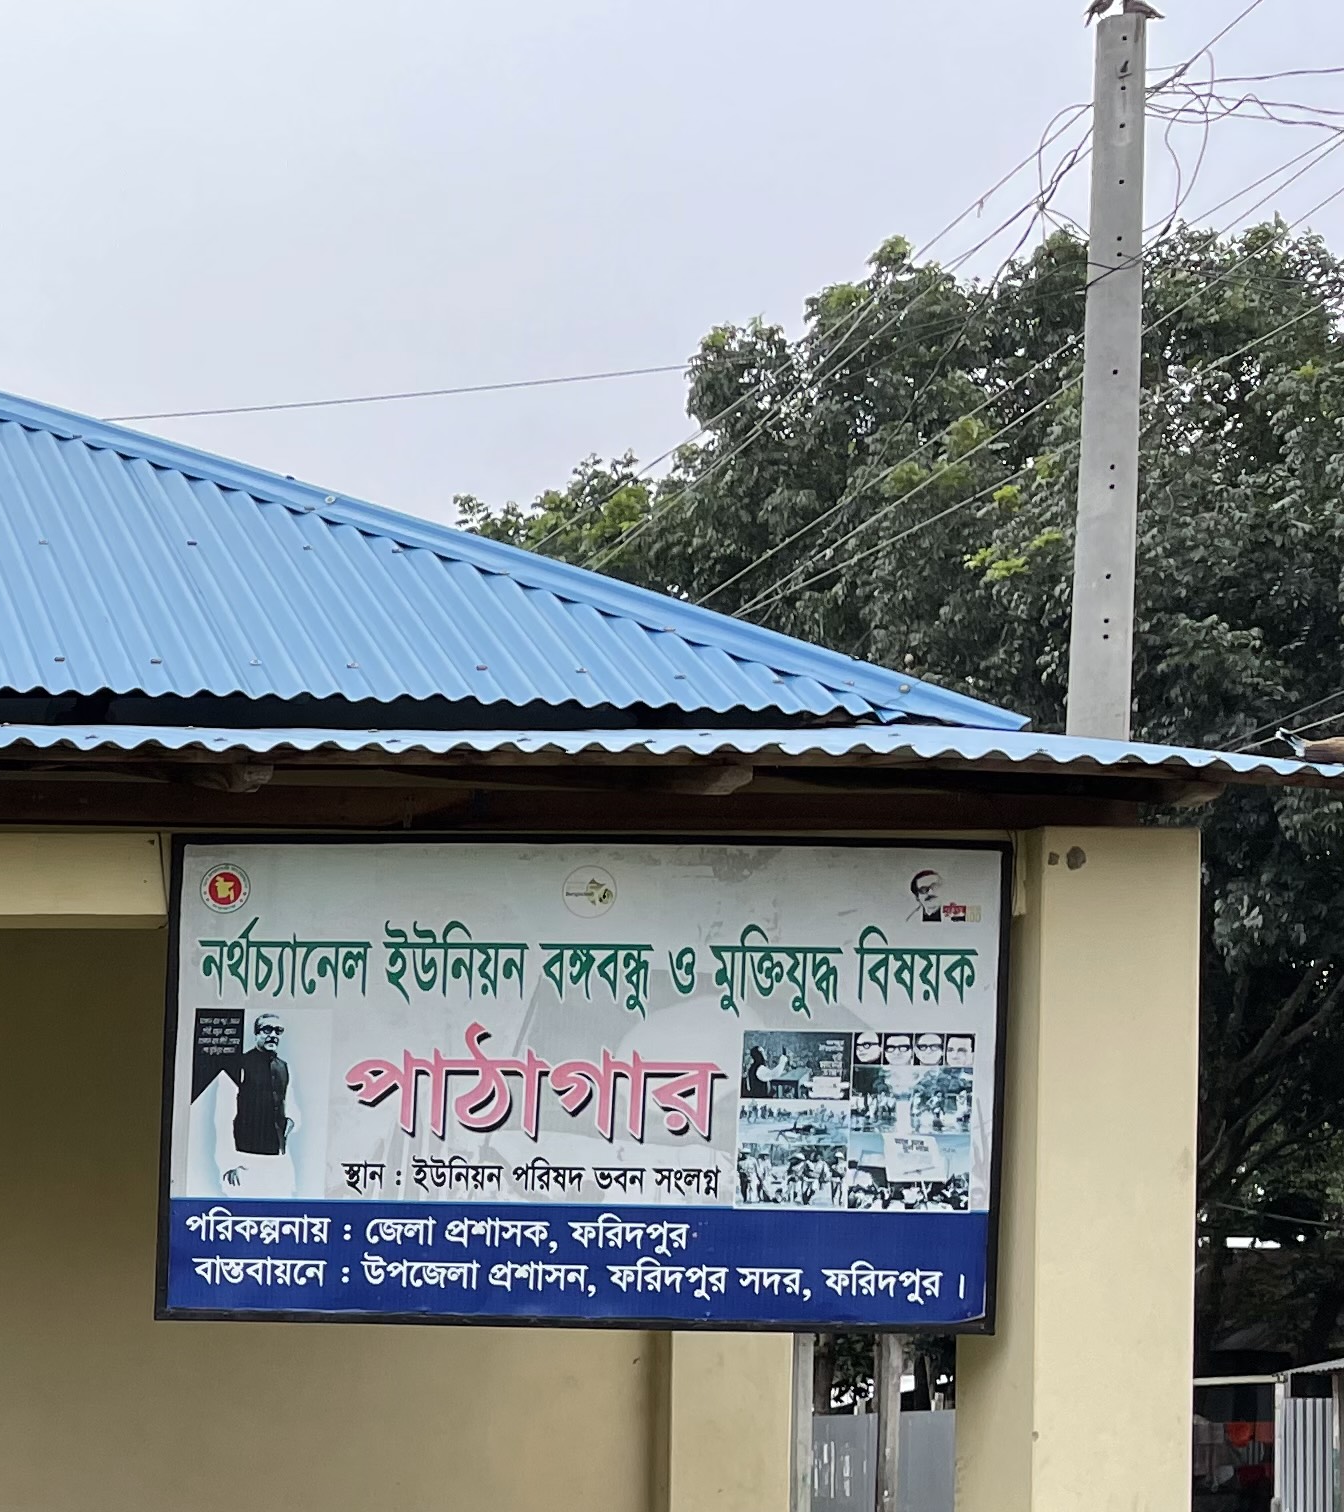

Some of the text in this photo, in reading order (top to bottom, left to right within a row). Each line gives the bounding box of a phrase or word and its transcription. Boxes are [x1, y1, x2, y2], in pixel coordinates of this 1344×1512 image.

[198, 917, 979, 1021] নর্থচ্যানেল ইউনিয়ন বঙ্গবন্ধু ও মুক্তিযুদ্ধ বিষয়ক
[345, 1021, 729, 1144] পাঠাগার
[341, 1160, 385, 1194] স্থান
[412, 1155, 504, 1193] ইউনিয়ন
[512, 1157, 586, 1193] পরিষদ
[592, 1166, 646, 1194] ভবন
[653, 1166, 722, 1199] সংলগ্ন
[185, 1206, 332, 1245] পরিকল্পনায়
[365, 1214, 436, 1246] জেলা
[445, 1215, 558, 1254] প্রশাসক,
[568, 1212, 690, 1258] ফরিদপুর
[191, 1255, 327, 1288] বাস্তবায়নে
[360, 1251, 481, 1290] উপজেলা
[488, 1260, 596, 1297] প্রশাসন,
[606, 1256, 730, 1301] ফরিদপুর
[736, 1266, 812, 1301] সদর,
[821, 1260, 943, 1305] ফরিদপুর
